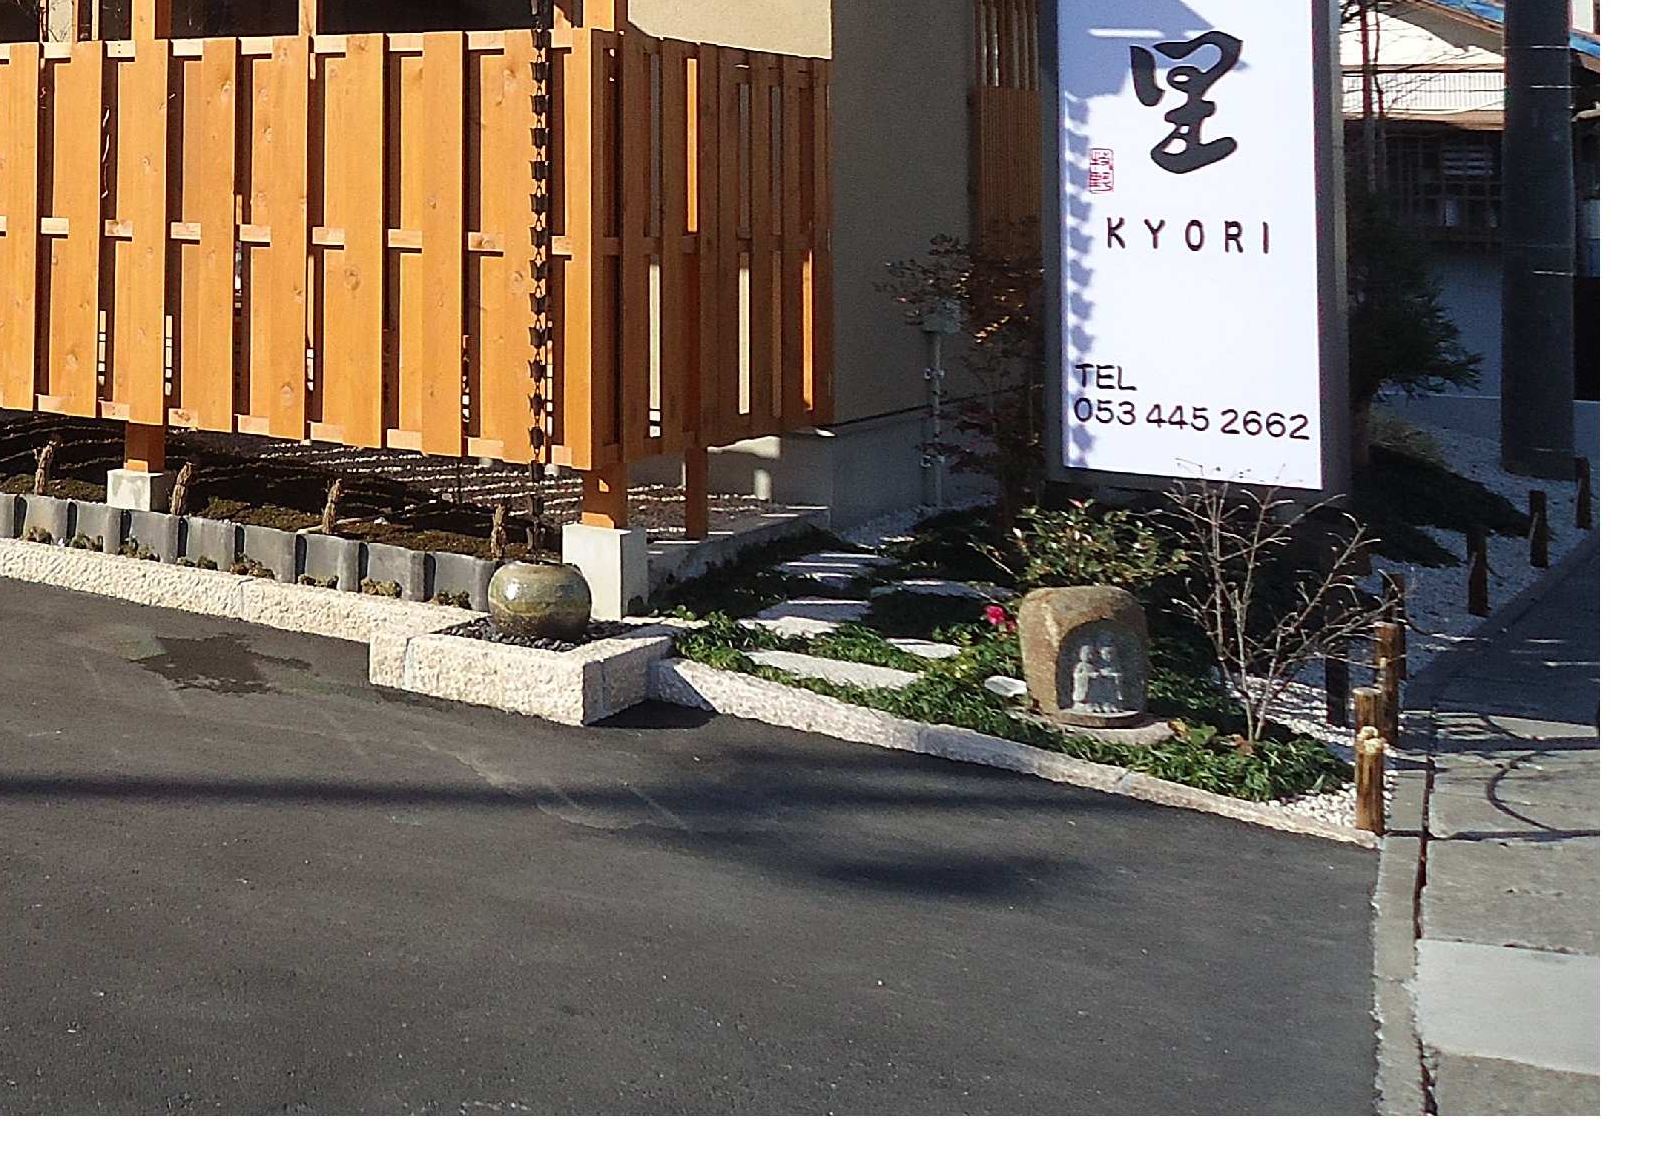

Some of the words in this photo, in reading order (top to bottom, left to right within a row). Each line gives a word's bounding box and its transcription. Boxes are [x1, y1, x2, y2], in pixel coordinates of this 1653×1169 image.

[1106, 217, 1270, 254] KYORI
[1073, 363, 1137, 391] TEL
[1073, 397, 1136, 426] 053
[1145, 404, 1209, 432] 445
[1220, 408, 1310, 441] 2662
